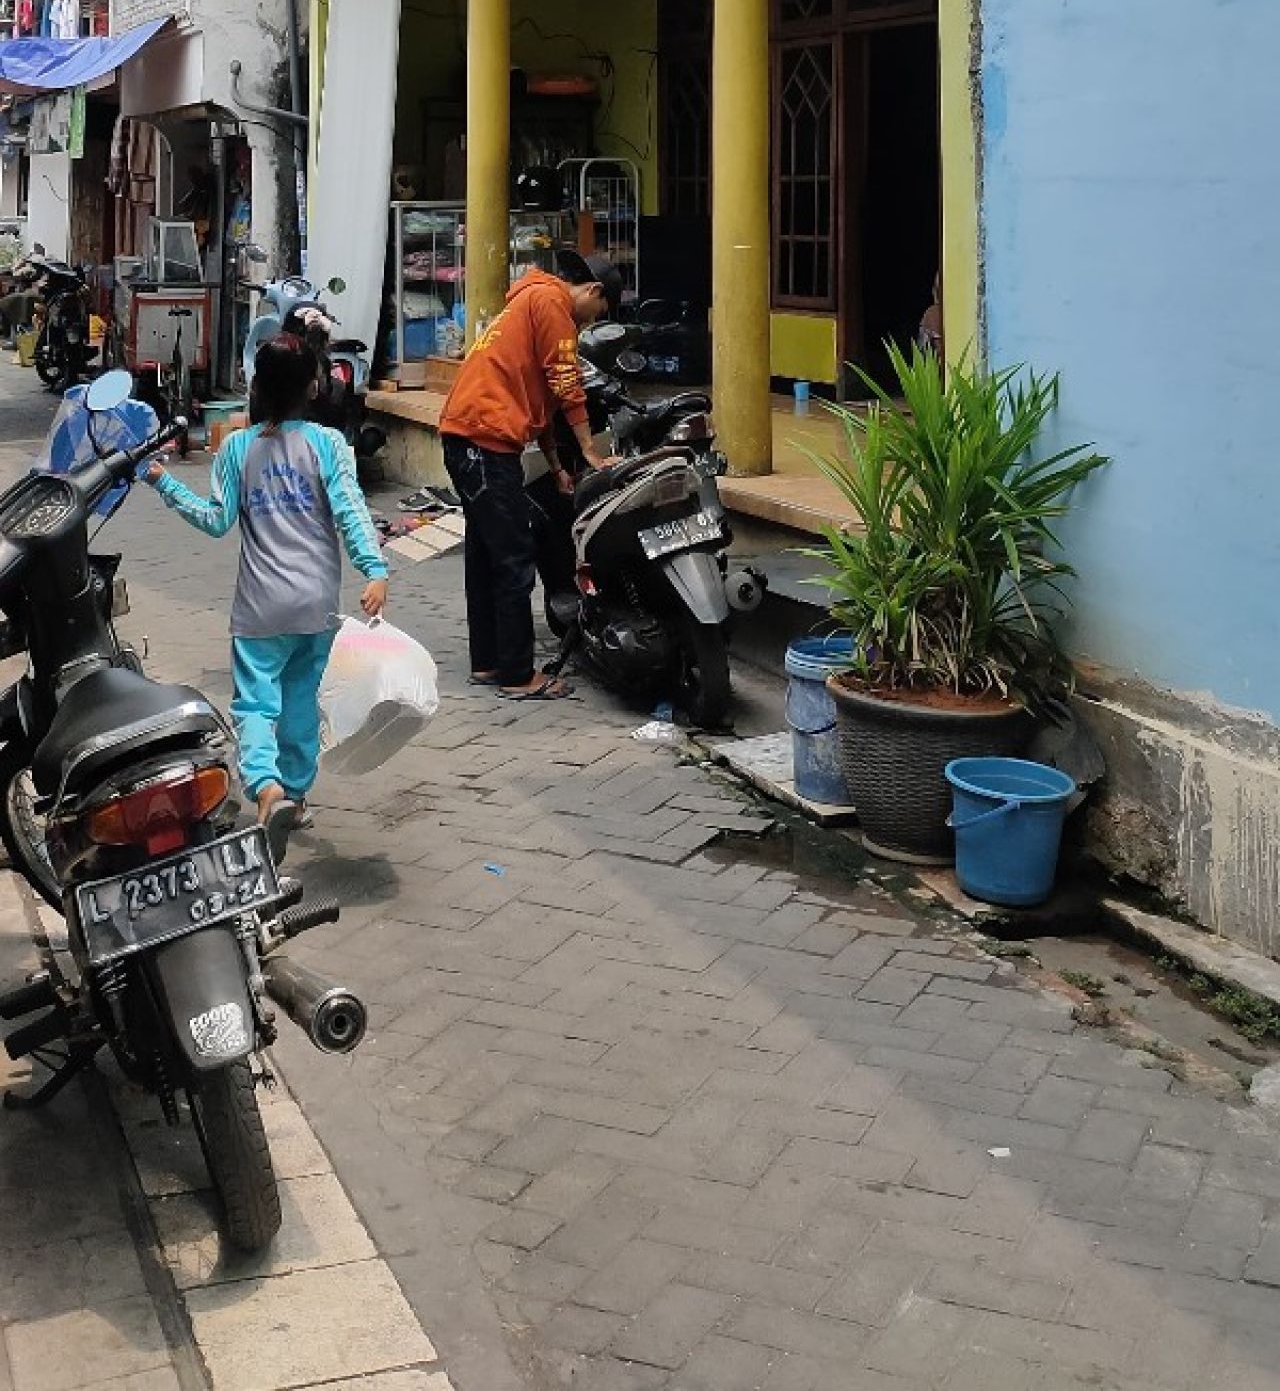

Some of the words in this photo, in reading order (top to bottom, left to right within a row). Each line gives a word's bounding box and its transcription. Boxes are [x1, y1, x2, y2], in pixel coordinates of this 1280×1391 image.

[88, 891, 111, 924] L
[125, 860, 200, 912] 2373
[221, 834, 262, 877] LX
